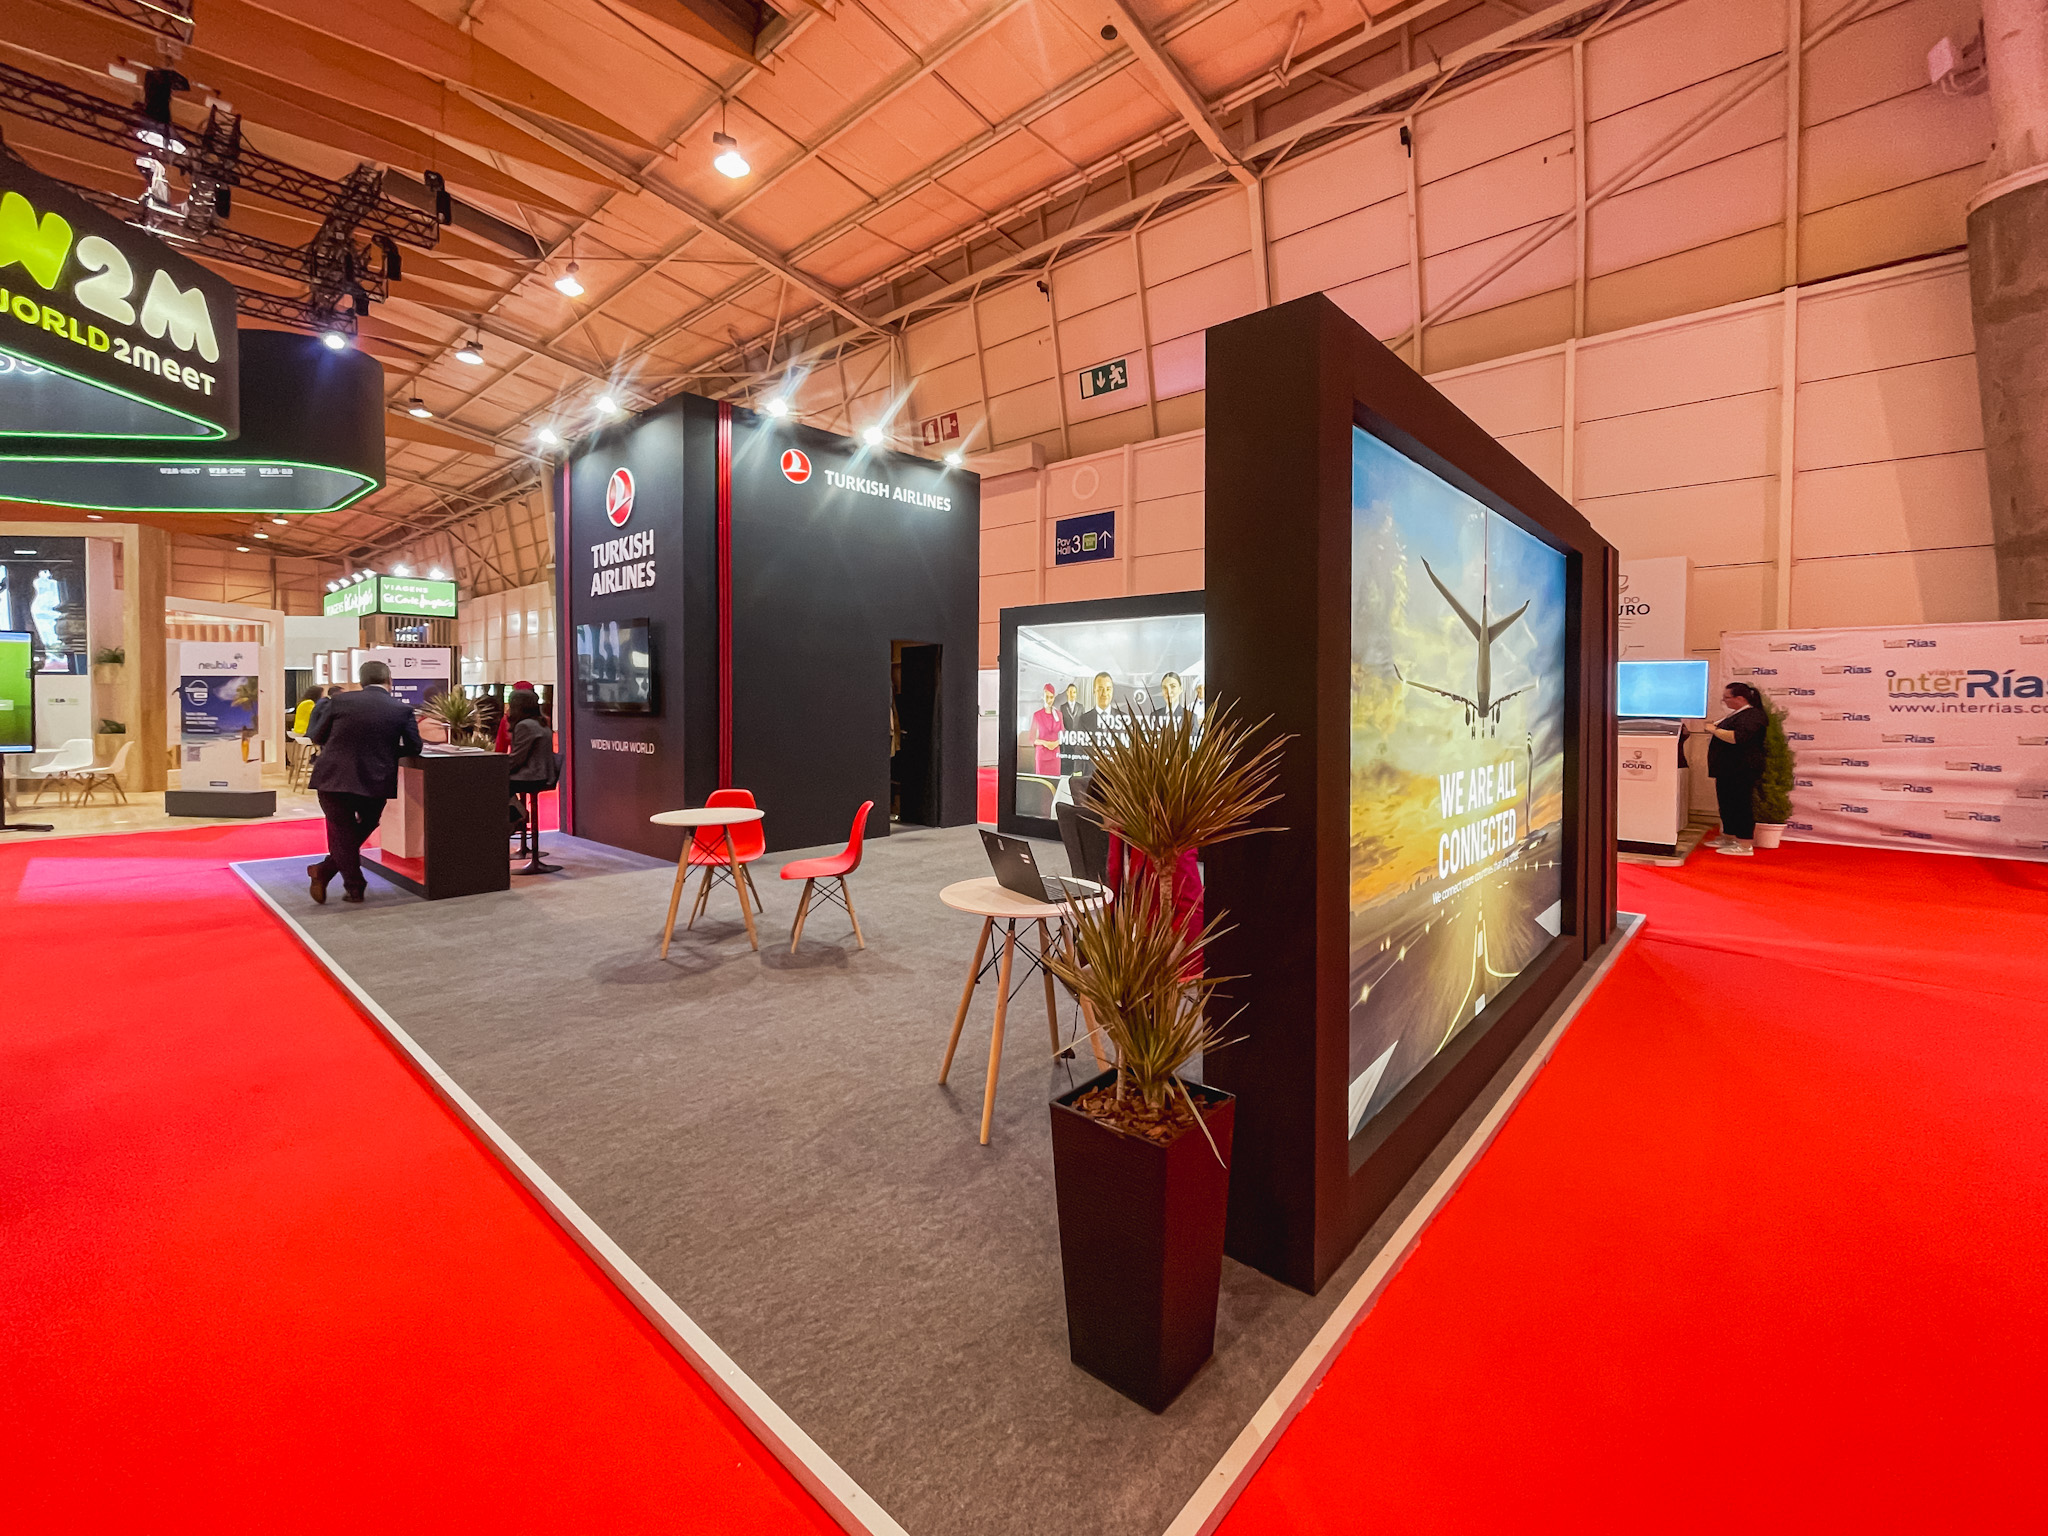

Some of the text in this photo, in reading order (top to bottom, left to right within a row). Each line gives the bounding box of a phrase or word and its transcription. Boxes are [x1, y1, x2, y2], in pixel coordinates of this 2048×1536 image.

[824, 469, 952, 512] TURKISH AIRLINES
[591, 529, 655, 569] TURKISH
[1071, 534, 1081, 554] 3
[384, 583, 429, 594] VIAGENS
[591, 560, 656, 597] AIRLINES
[1623, 596, 1640, 604] DO
[1886, 669, 2048, 699] interRía
[591, 739, 655, 755] WIDEN YOUR WORLD
[1440, 760, 1517, 820] WE ARE ALL
[1439, 808, 1517, 880] CONNECTED
[1432, 891, 1442, 906] We
